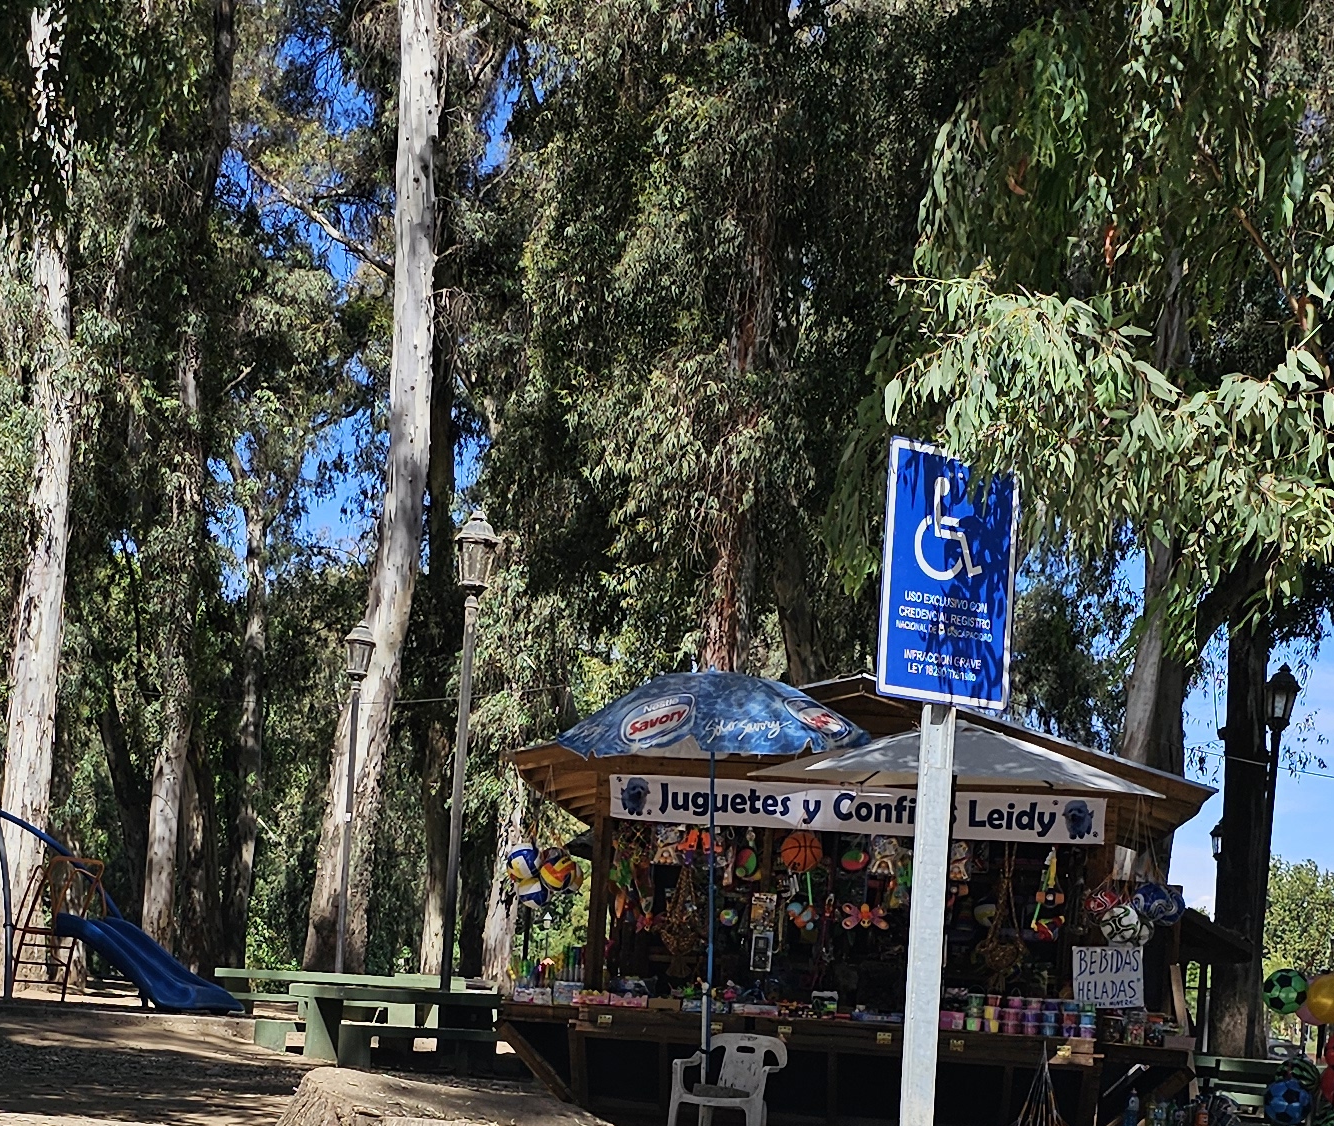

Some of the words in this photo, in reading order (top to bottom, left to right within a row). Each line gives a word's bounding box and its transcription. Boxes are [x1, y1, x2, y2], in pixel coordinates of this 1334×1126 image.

[905, 590, 922, 603] USO
[924, 594, 968, 610] EXCLUSIVO
[969, 602, 987, 614] CON
[899, 605, 949, 623] CREDENCIAL
[950, 614, 991, 630] REGISTRO
[908, 662, 924, 674] LEY
[953, 656, 982, 670] GRAVE
[629, 709, 687, 736] Savory
[659, 782, 791, 817] Juguetes
[802, 799, 821, 824] y
[968, 799, 1057, 838] Leidy
[1076, 948, 1140, 976] BEBIDAS
